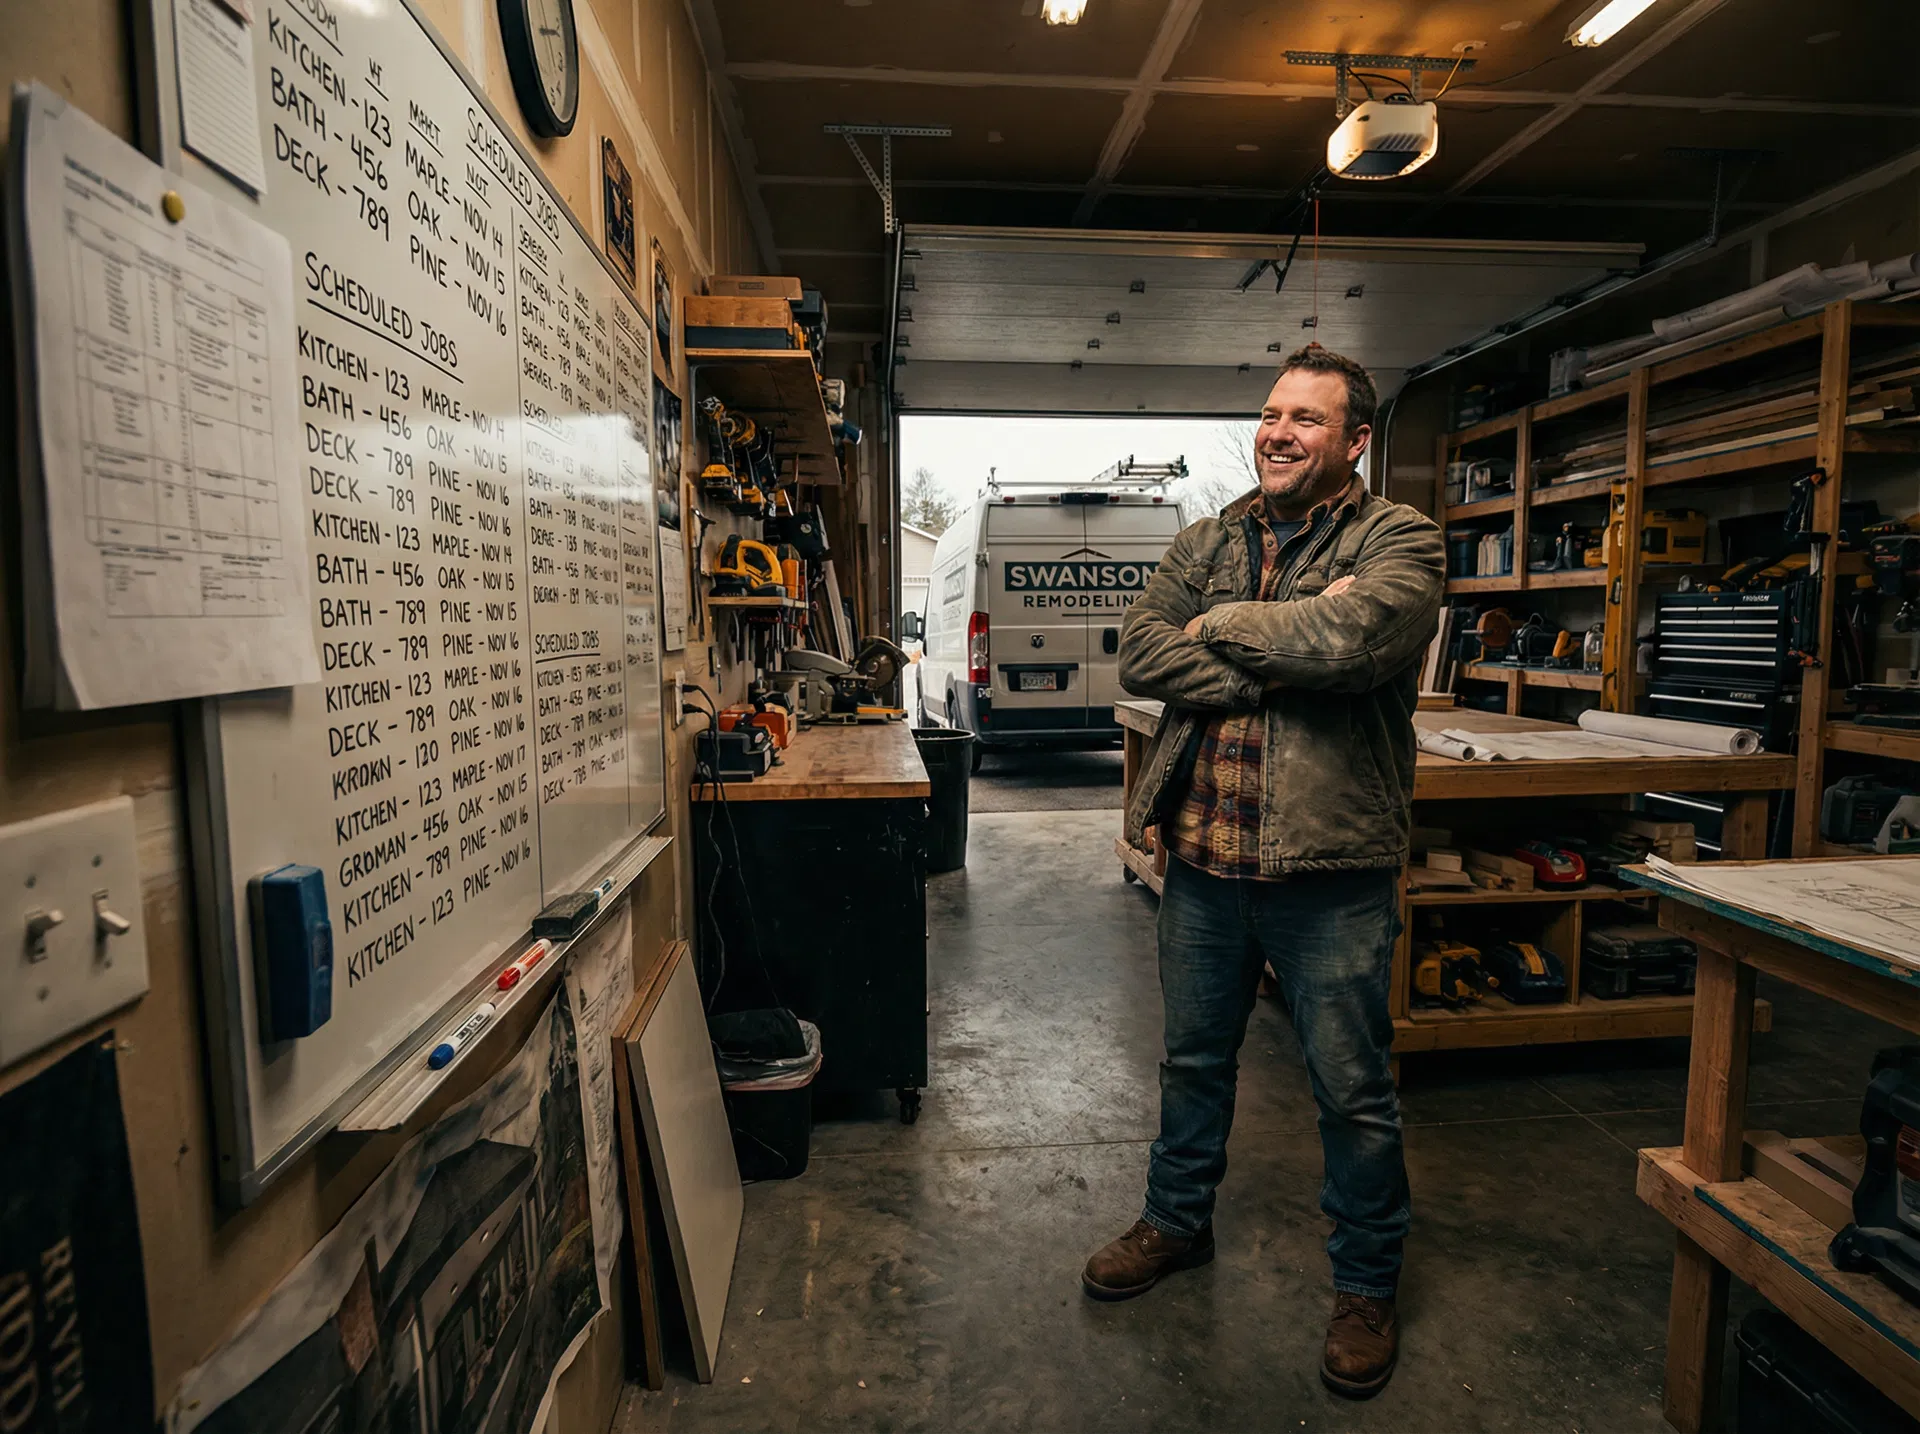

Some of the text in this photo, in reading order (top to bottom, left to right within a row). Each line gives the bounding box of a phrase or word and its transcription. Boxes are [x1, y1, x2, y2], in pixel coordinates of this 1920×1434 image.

[268, 8, 345, 106] KITCHEN
[365, 100, 391, 147] 123
[406, 140, 449, 205] MAPLE
[464, 199, 487, 240] NOV
[271, 66, 326, 140] BATH
[351, 134, 387, 190] 456
[408, 191, 442, 241] OAK
[466, 242, 489, 282] NOV
[467, 107, 560, 240] SCHEDULED JOBS
[274, 123, 330, 196] DECK
[353, 185, 389, 241] 789
[411, 235, 447, 288] PINE
[468, 285, 491, 323] NOV
[305, 252, 412, 339] SCHEDULED
[421, 321, 457, 367] JOBS
[298, 326, 367, 382] KITCHEN
[386, 367, 409, 400] 123
[423, 386, 461, 422] MAPLE
[473, 410, 491, 434] NOV
[302, 375, 354, 421] BATH
[380, 405, 411, 440] 456
[427, 425, 456, 457] OAK
[474, 445, 494, 469] NOV
[305, 422, 358, 464] DECK
[383, 447, 413, 479] 789
[429, 461, 460, 492] PINE
[477, 479, 495, 501] NOV
[310, 466, 361, 503] DECK
[387, 485, 414, 514] 789
[431, 496, 462, 526] PINE
[478, 511, 498, 532] NOV
[530, 497, 553, 520] BATH
[313, 509, 380, 545] KITCHEN
[397, 525, 420, 551] 123
[433, 533, 470, 558] MAPLE
[482, 543, 500, 562] NOV
[317, 554, 367, 584] BATH
[393, 561, 423, 587] 456
[438, 567, 466, 589] OAK
[483, 571, 501, 590] NOV
[532, 555, 554, 575] BATH
[1010, 565, 1159, 588] SWANSON
[320, 598, 372, 628] BATH
[396, 600, 425, 624] 789
[440, 600, 471, 623] PINE
[486, 603, 504, 621] NOV
[1023, 595, 1143, 608] REMODELIN
[323, 641, 375, 671] DECK
[398, 635, 428, 661] 789
[443, 634, 473, 656] PINE
[488, 633, 506, 652] NOV
[535, 630, 599, 655] SCHEDULED JOBS
[326, 679, 390, 713] KITCHEN
[409, 672, 431, 696] 123
[445, 667, 478, 689] MAPLE
[490, 662, 508, 681] NOV
[539, 695, 561, 717] BATH
[329, 720, 380, 757] DECK
[406, 705, 434, 733] 789
[449, 696, 476, 721] OAK
[492, 690, 509, 709] NOV
[451, 726, 481, 754] PINE
[494, 718, 512, 739] NOV
[540, 721, 562, 745] DECK
[542, 748, 563, 774] BATH
[336, 796, 397, 846] KITCHEN
[419, 778, 442, 807] 123
[453, 760, 486, 792] MAPLE
[496, 750, 513, 773] NOV
[423, 810, 448, 841] 456
[459, 795, 483, 824] OAK
[497, 780, 514, 804] NOV
[544, 777, 565, 804] DECK
[343, 867, 412, 934] KITCHEN
[426, 846, 450, 878] 789
[461, 826, 486, 861] PINE
[500, 811, 516, 836] NOV
[347, 915, 414, 988] KITCHEN
[432, 889, 453, 925] 123
[464, 864, 490, 902] PINE
[502, 845, 519, 873] NOV
